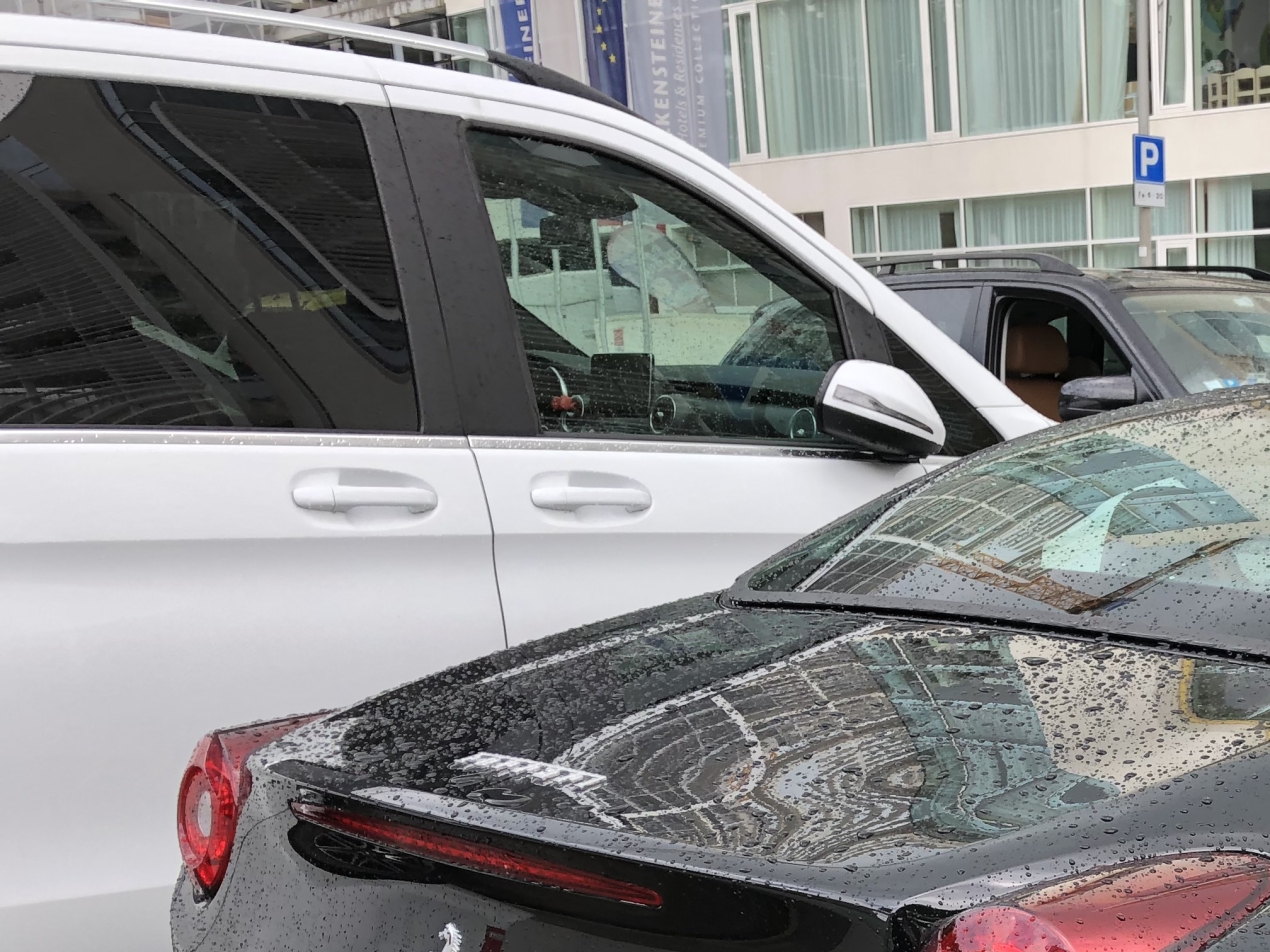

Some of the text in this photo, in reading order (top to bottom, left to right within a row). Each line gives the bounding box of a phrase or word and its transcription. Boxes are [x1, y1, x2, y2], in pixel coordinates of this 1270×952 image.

[648, 0, 671, 133] KENSTEINE
[671, 5, 686, 82] Residences
[675, 86, 686, 97] &
[696, 94, 708, 154] EMIUM
[1140, 141, 1159, 177] P
